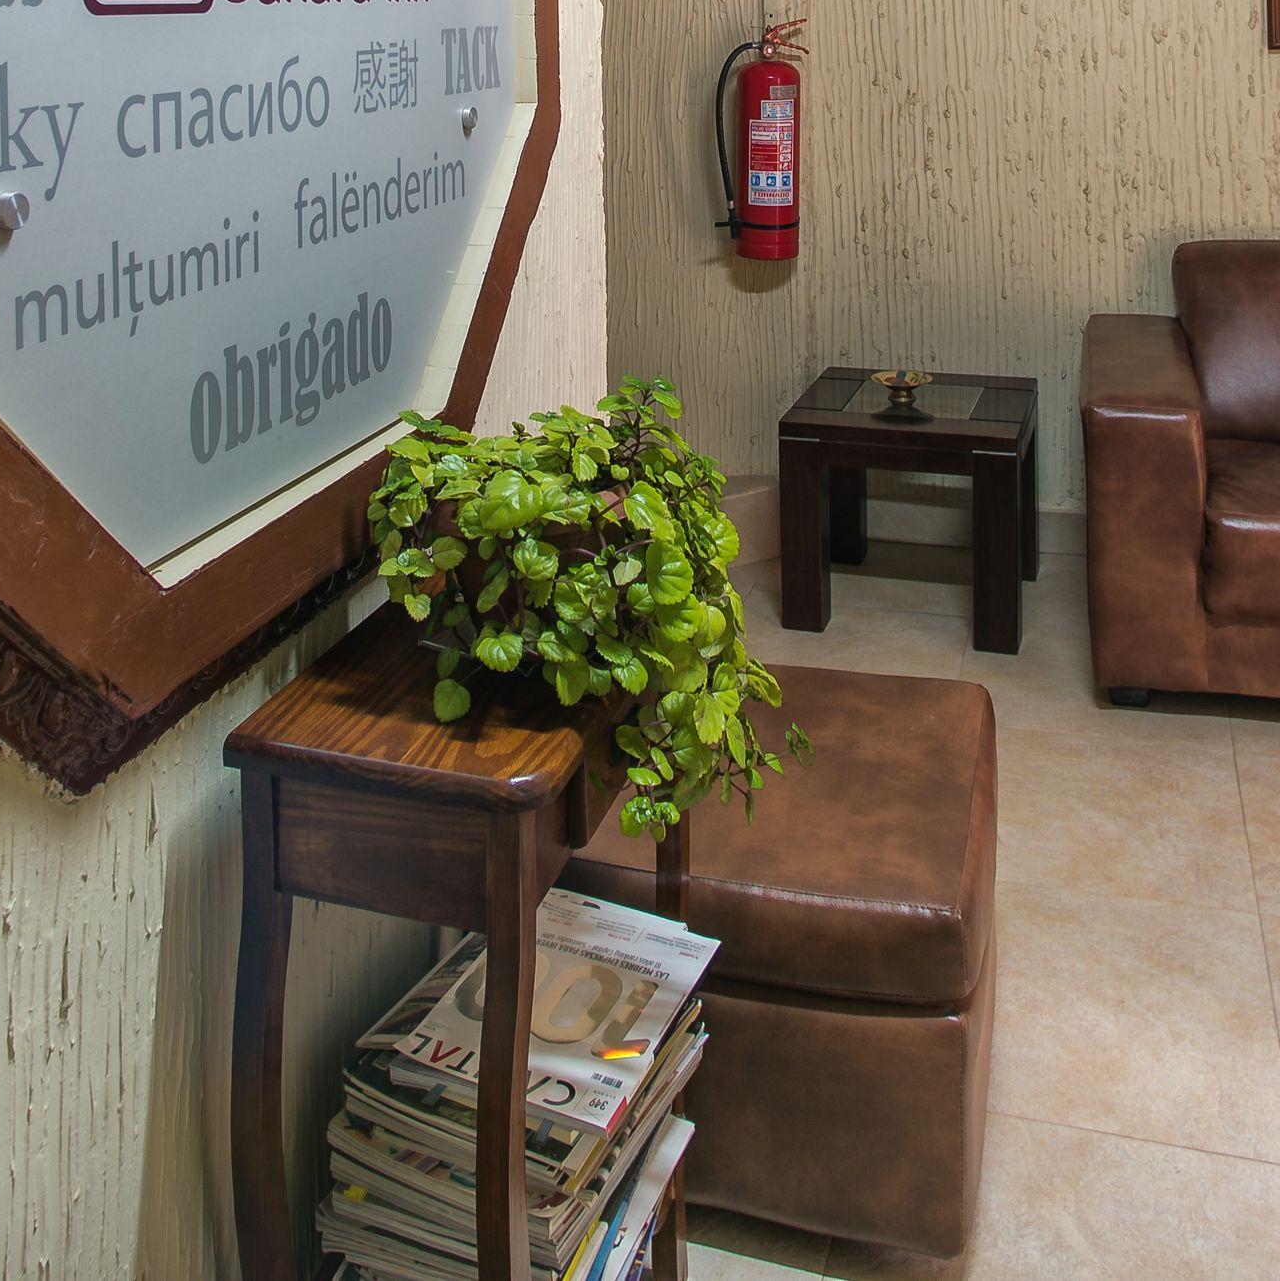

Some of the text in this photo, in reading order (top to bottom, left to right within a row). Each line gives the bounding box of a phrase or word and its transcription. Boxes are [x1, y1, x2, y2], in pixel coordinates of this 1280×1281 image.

[352, 38, 419, 115] 感謝
[440, 25, 501, 96] TACK
[115, 55, 331, 158] спасибо
[294, 151, 466, 250] falënderim
[189, 291, 393, 465] obrigado
[578, 949, 620, 967] EMPRESAS
[619, 960, 654, 976] MEJORES
[656, 970, 671, 981] LAS
[410, 1032, 577, 1107] CATAL
[588, 1098, 609, 1111] 349
